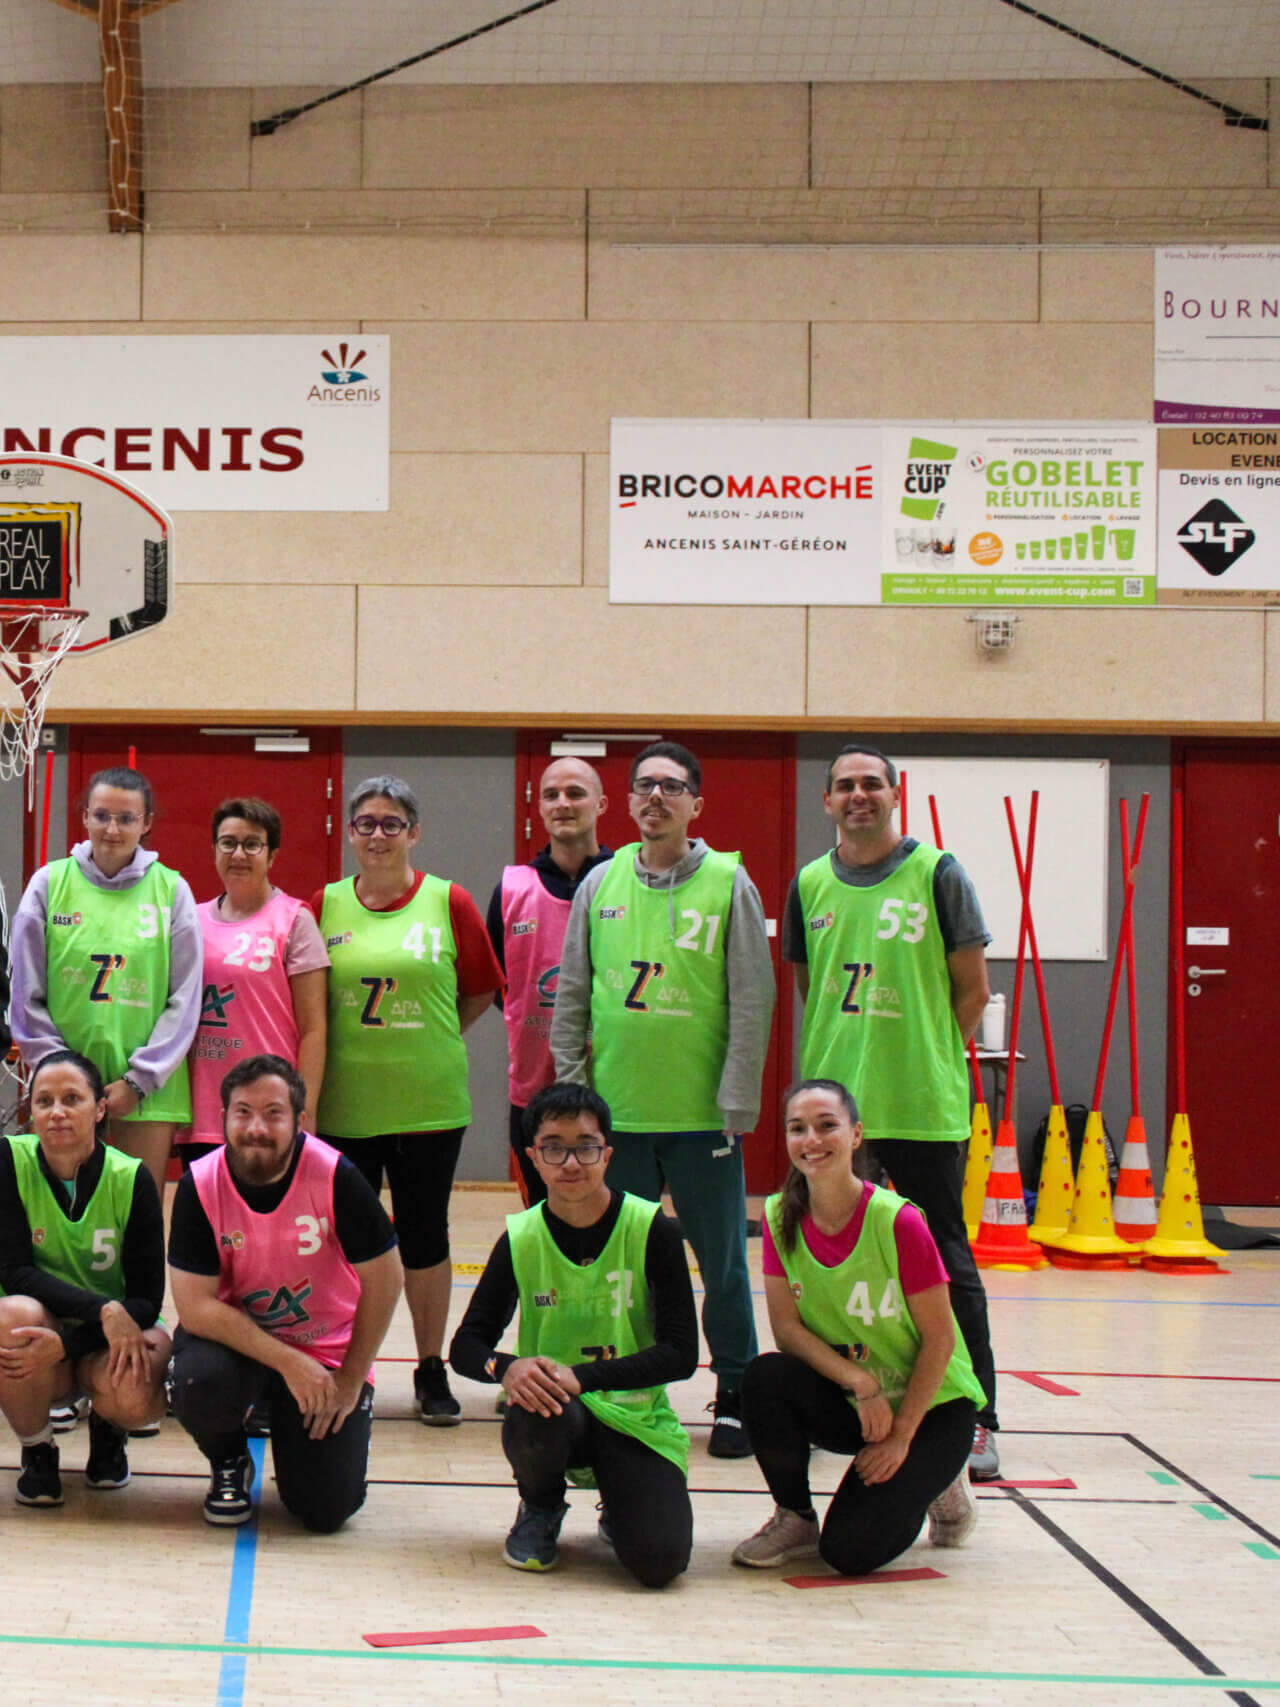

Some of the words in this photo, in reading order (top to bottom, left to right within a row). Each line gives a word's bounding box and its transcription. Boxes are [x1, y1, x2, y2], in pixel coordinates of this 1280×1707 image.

[306, 384, 381, 402] Ancenis
[1192, 432, 1278, 446] LOCATION
[1013, 448, 1083, 456] PERSONNALISEZ
[1085, 448, 1113, 456] VOTRE
[907, 463, 952, 476] EVENT
[985, 460, 1144, 487] GOBELET
[1180, 473, 1220, 486] Devis
[1225, 475, 1242, 486] en
[619, 465, 873, 500] BRICOMARCHÉ
[905, 476, 946, 494] CUP
[985, 486, 1141, 508] RÉUTILISABLE
[688, 510, 740, 519] MAISON
[755, 511, 804, 520] JARDIN
[644, 538, 716, 550] ANCENIS
[723, 535, 847, 551] SAINT-GÉRÉON
[53, 915, 72, 926] BASK
[877, 898, 928, 944] 53
[675, 909, 720, 955] 21
[223, 932, 276, 972] 23
[402, 922, 441, 964] 41
[91, 1229, 116, 1271] 5
[846, 1278, 903, 1326] 44
